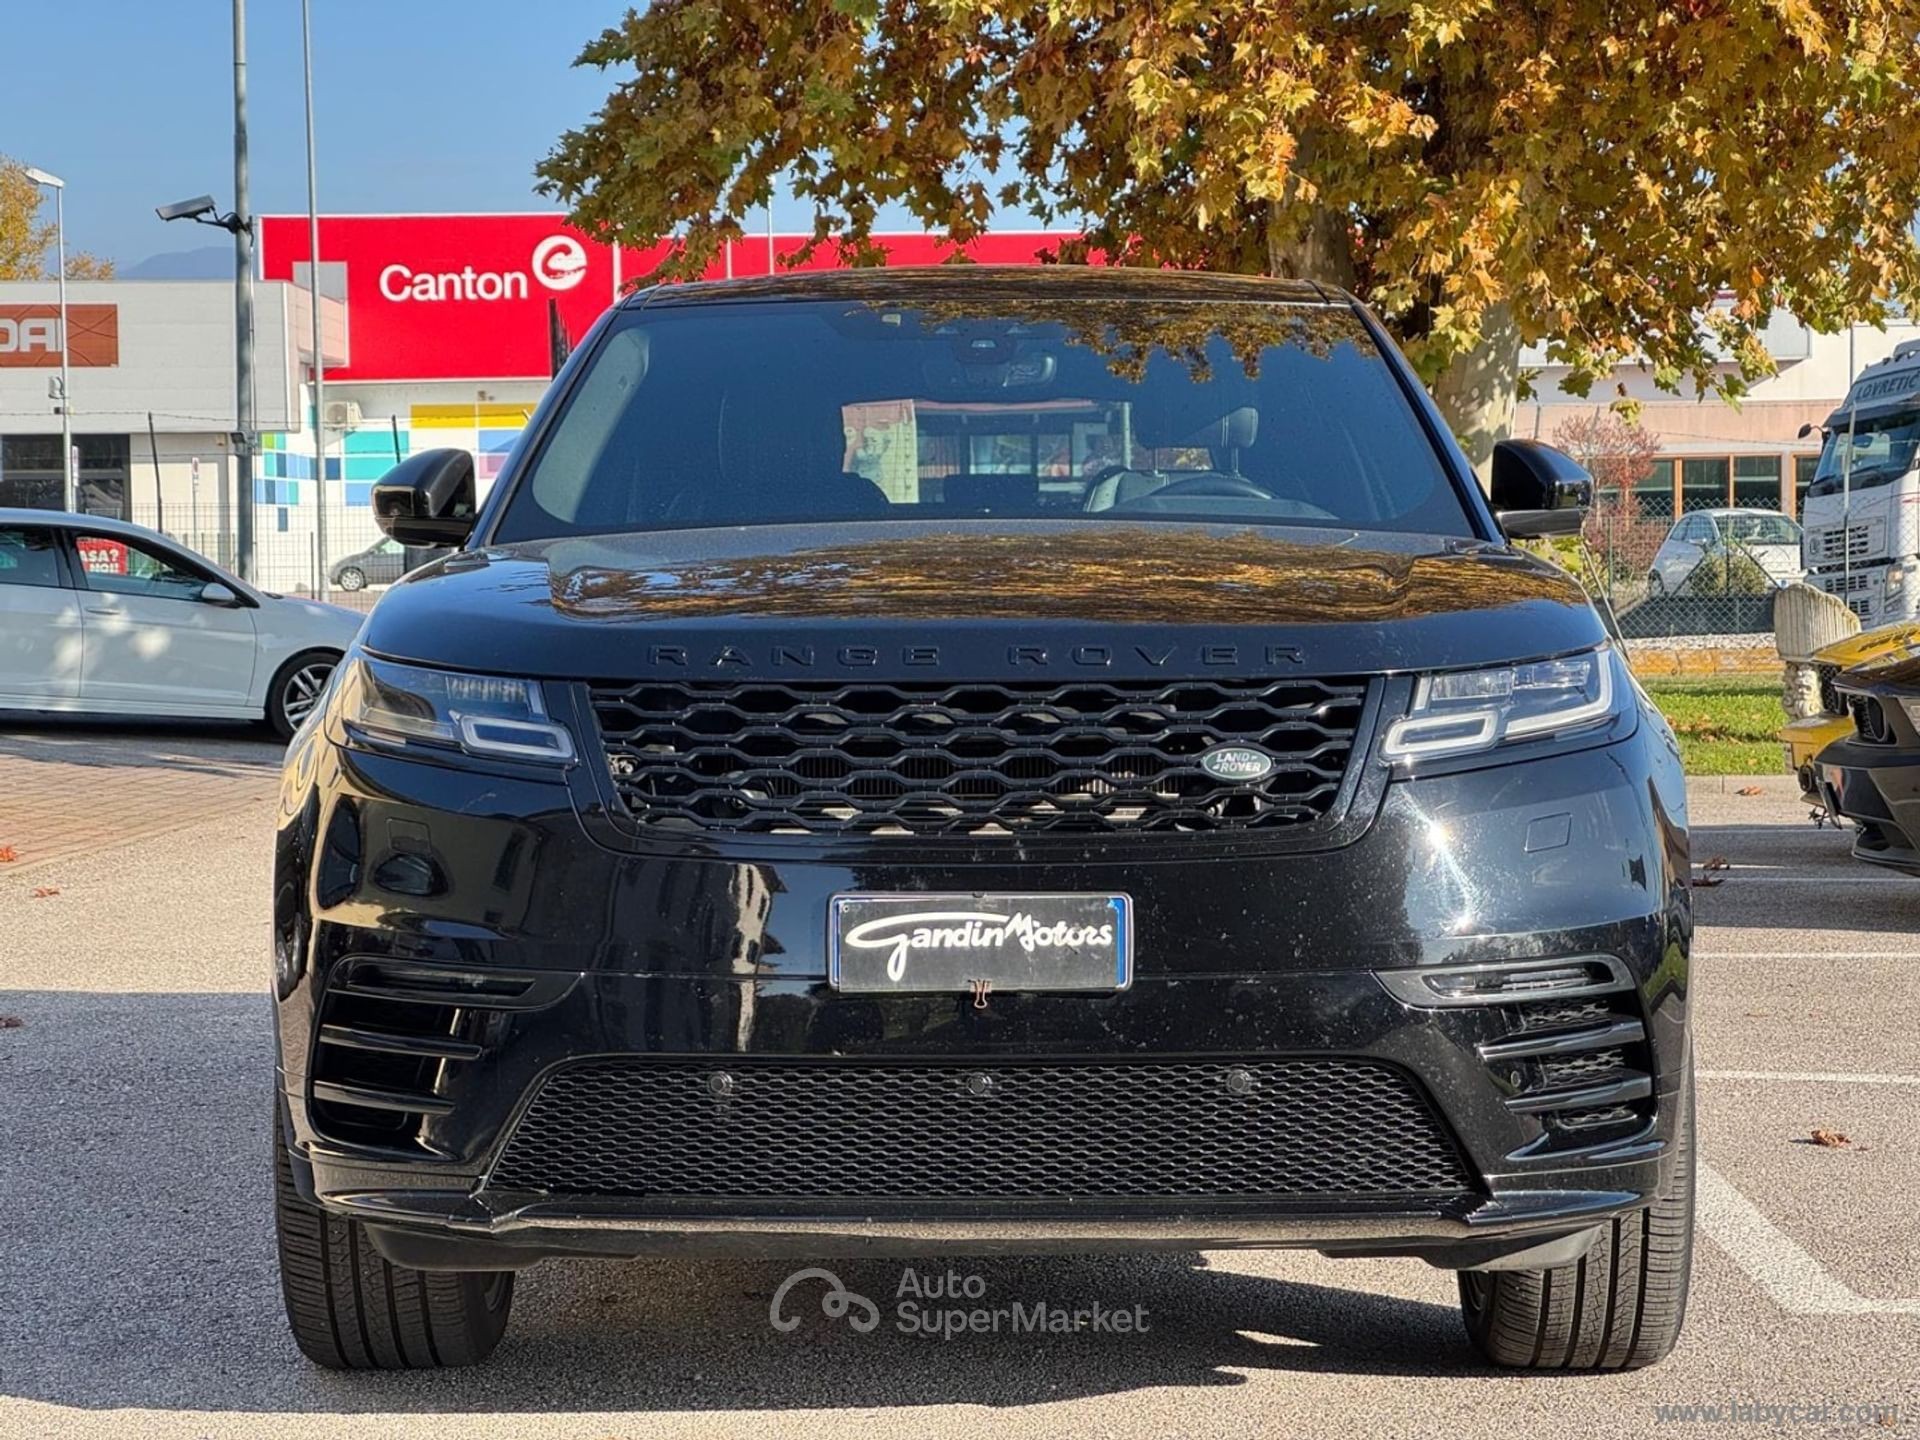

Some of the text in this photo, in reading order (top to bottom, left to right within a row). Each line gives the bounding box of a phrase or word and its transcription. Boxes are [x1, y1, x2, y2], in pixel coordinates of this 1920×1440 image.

[379, 263, 529, 302] Canton
[649, 645, 1305, 666] RANGE ROVER
[1219, 761, 1262, 773] ROVER
